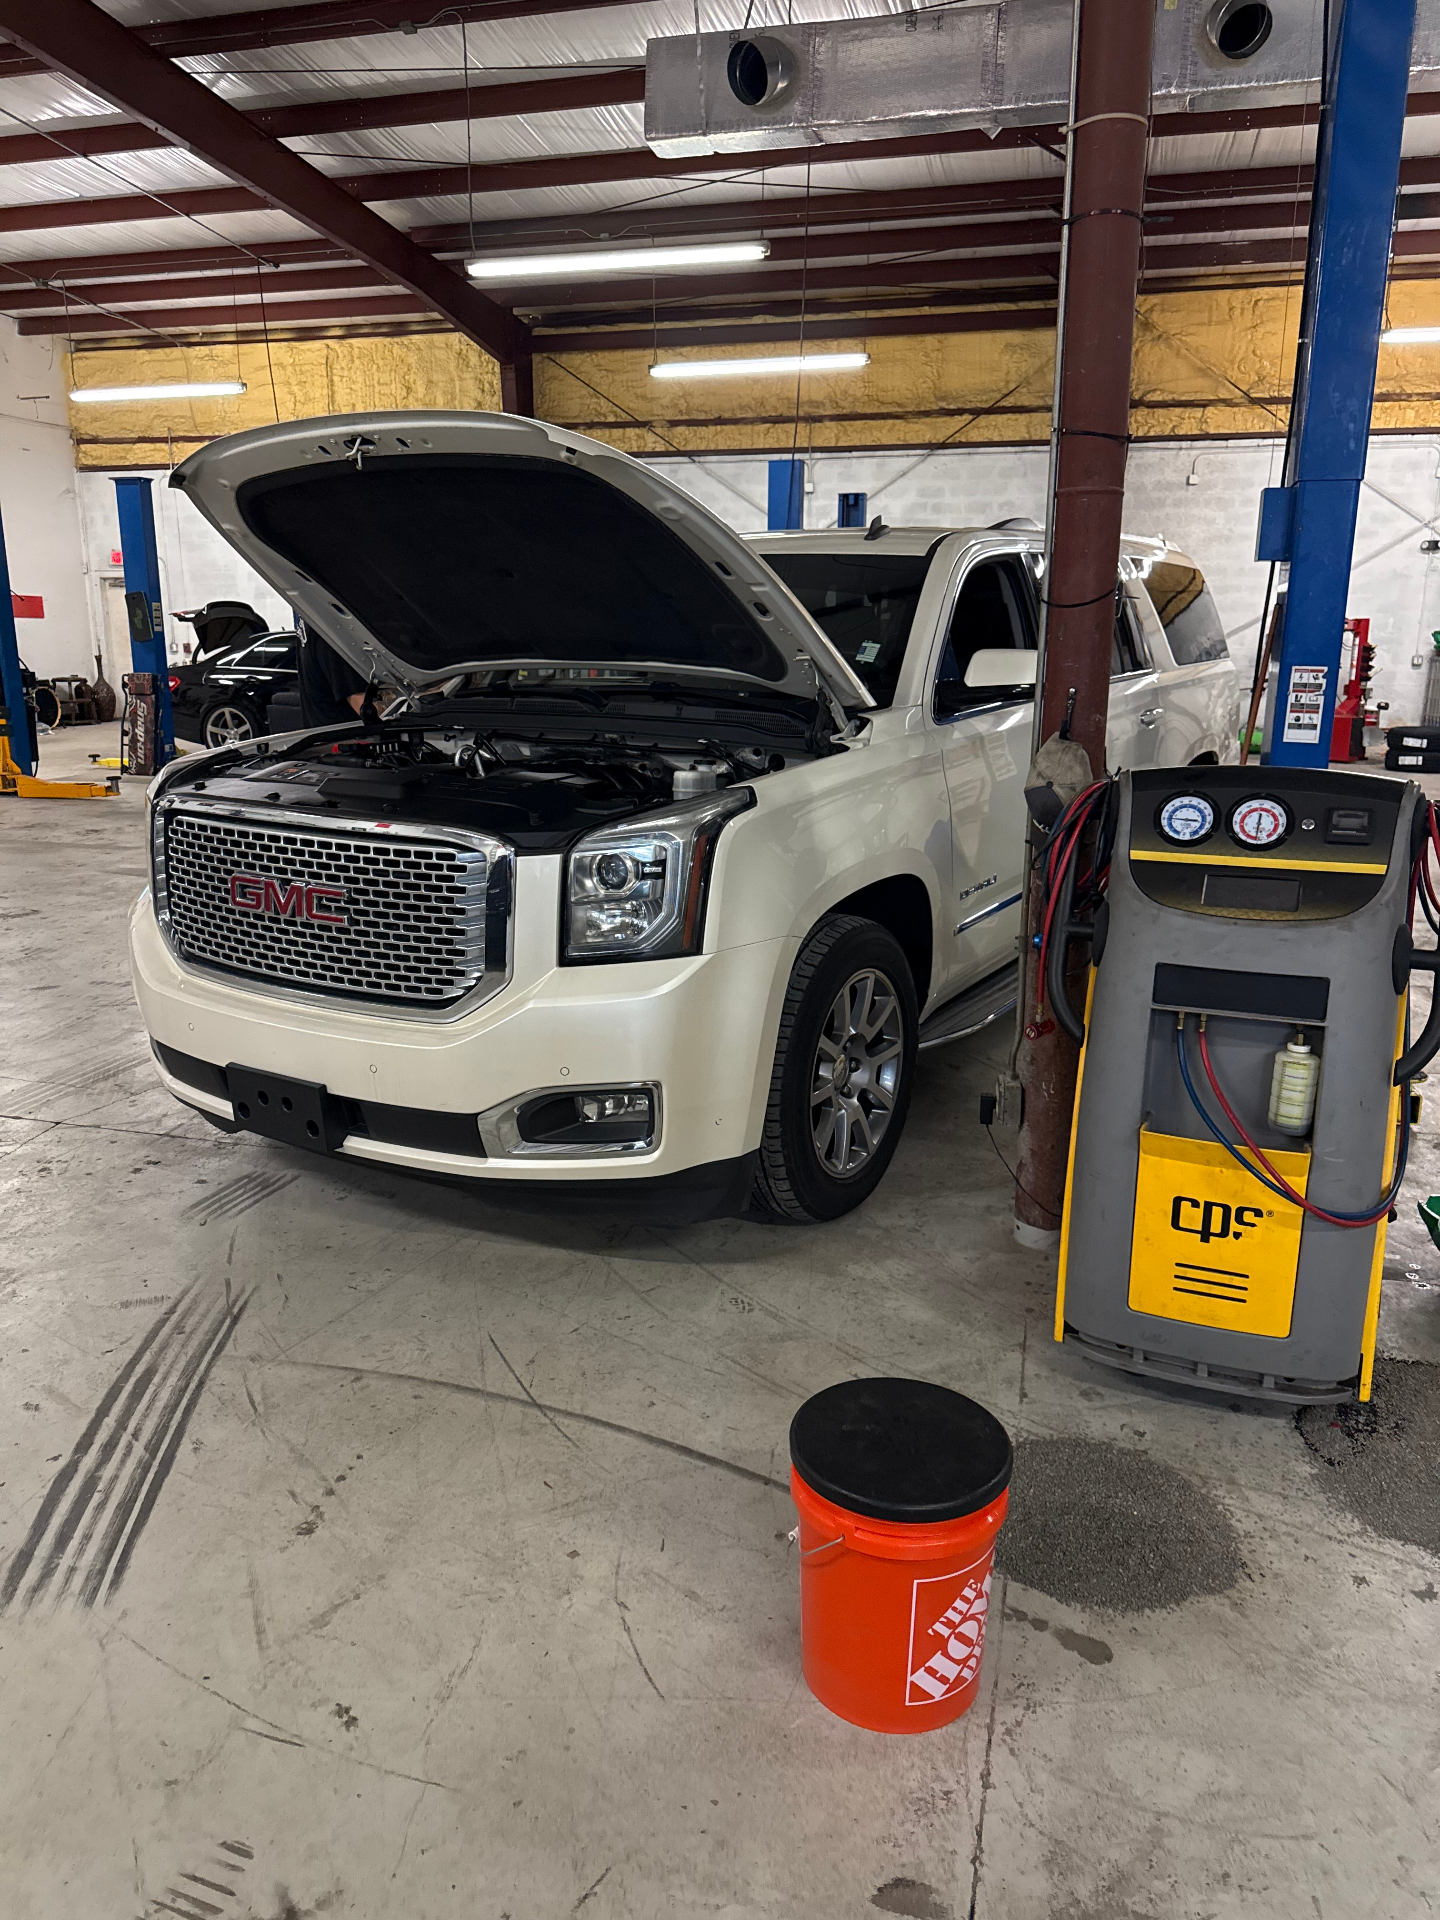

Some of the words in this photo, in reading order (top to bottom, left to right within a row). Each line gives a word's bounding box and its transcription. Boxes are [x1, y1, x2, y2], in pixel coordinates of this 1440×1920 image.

[134, 699, 148, 766] Snap-on
[230, 873, 348, 925] GMC
[910, 1555, 995, 1699] HOM
[926, 1578, 982, 1639] THE
